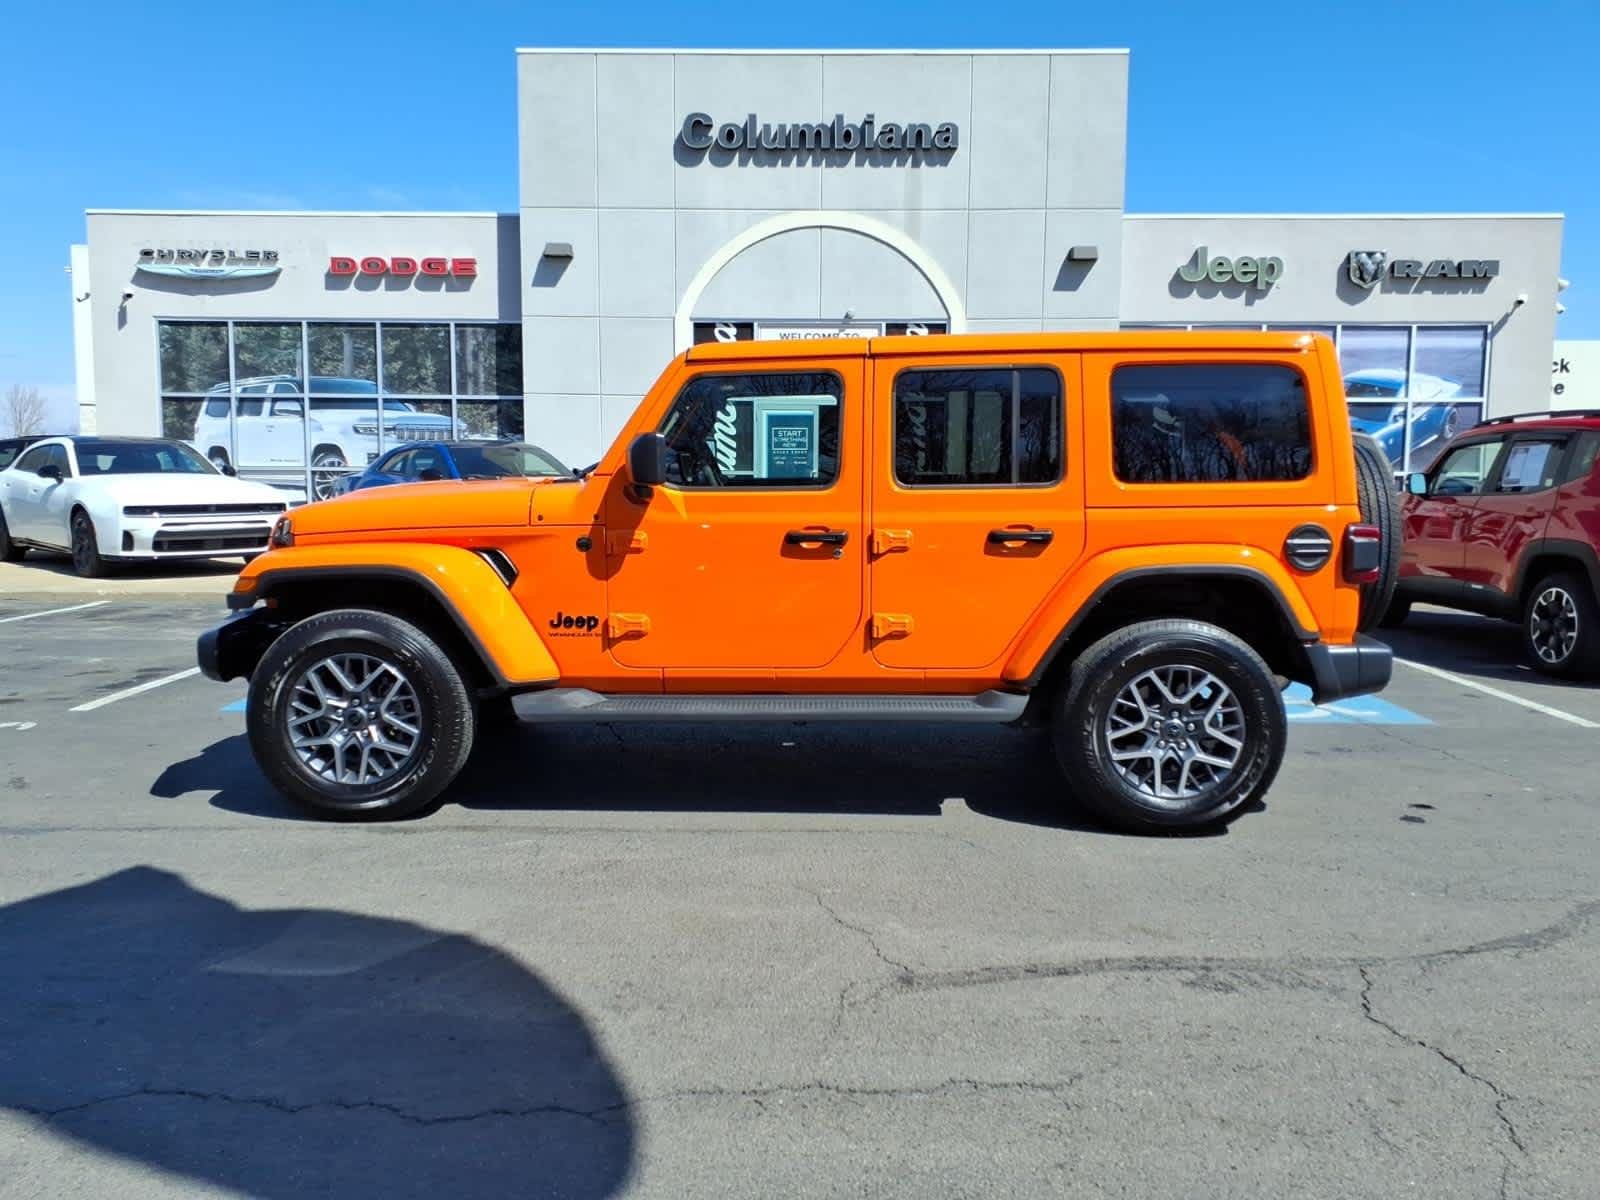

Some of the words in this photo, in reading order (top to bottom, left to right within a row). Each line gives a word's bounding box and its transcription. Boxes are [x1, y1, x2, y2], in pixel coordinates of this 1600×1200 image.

[680, 111, 960, 149] Columbiana
[139, 248, 280, 262] CHRYSLER
[330, 256, 478, 276] DODGE
[1180, 246, 1284, 290] Jeep
[1393, 259, 1501, 278] RAM
[549, 611, 600, 632] Jeep
